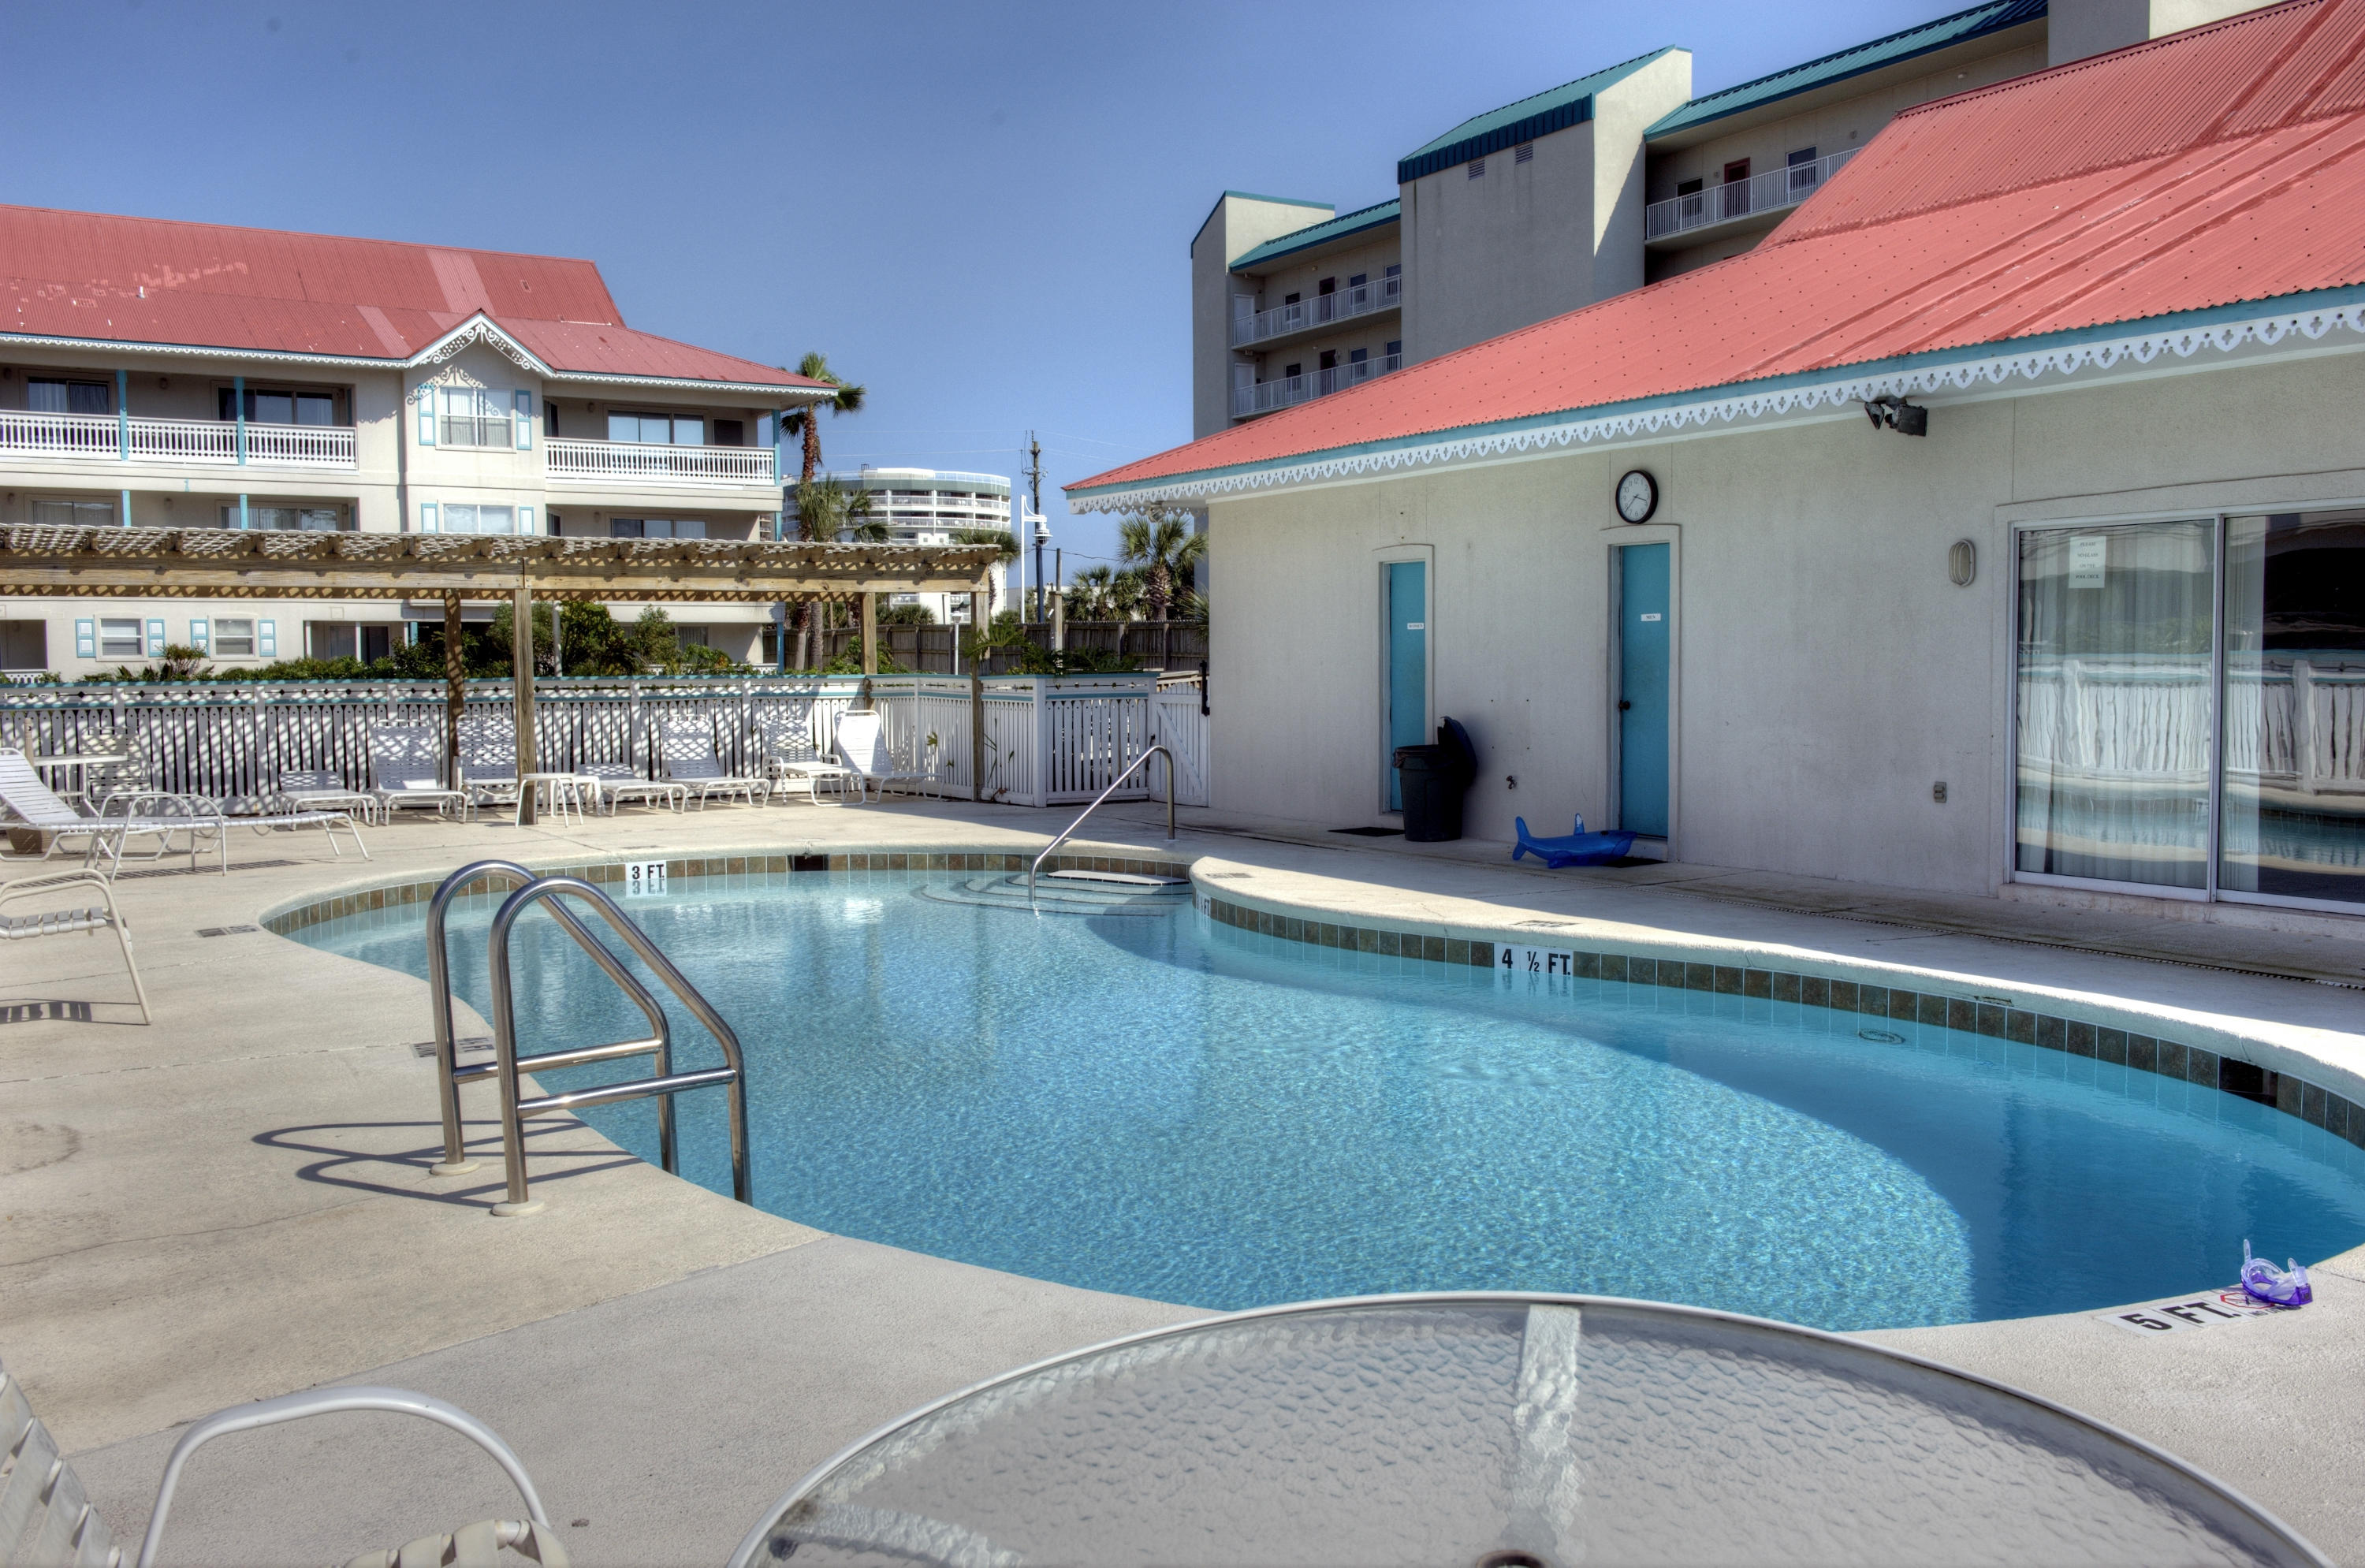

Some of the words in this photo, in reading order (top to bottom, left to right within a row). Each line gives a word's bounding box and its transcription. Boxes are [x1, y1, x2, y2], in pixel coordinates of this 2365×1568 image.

[632, 866, 640, 880] 3
[1502, 948, 1513, 969] 4
[1548, 953, 1570, 975] FT.
[2118, 1313, 2173, 1330] 5
[2161, 1302, 2242, 1324] FT.
